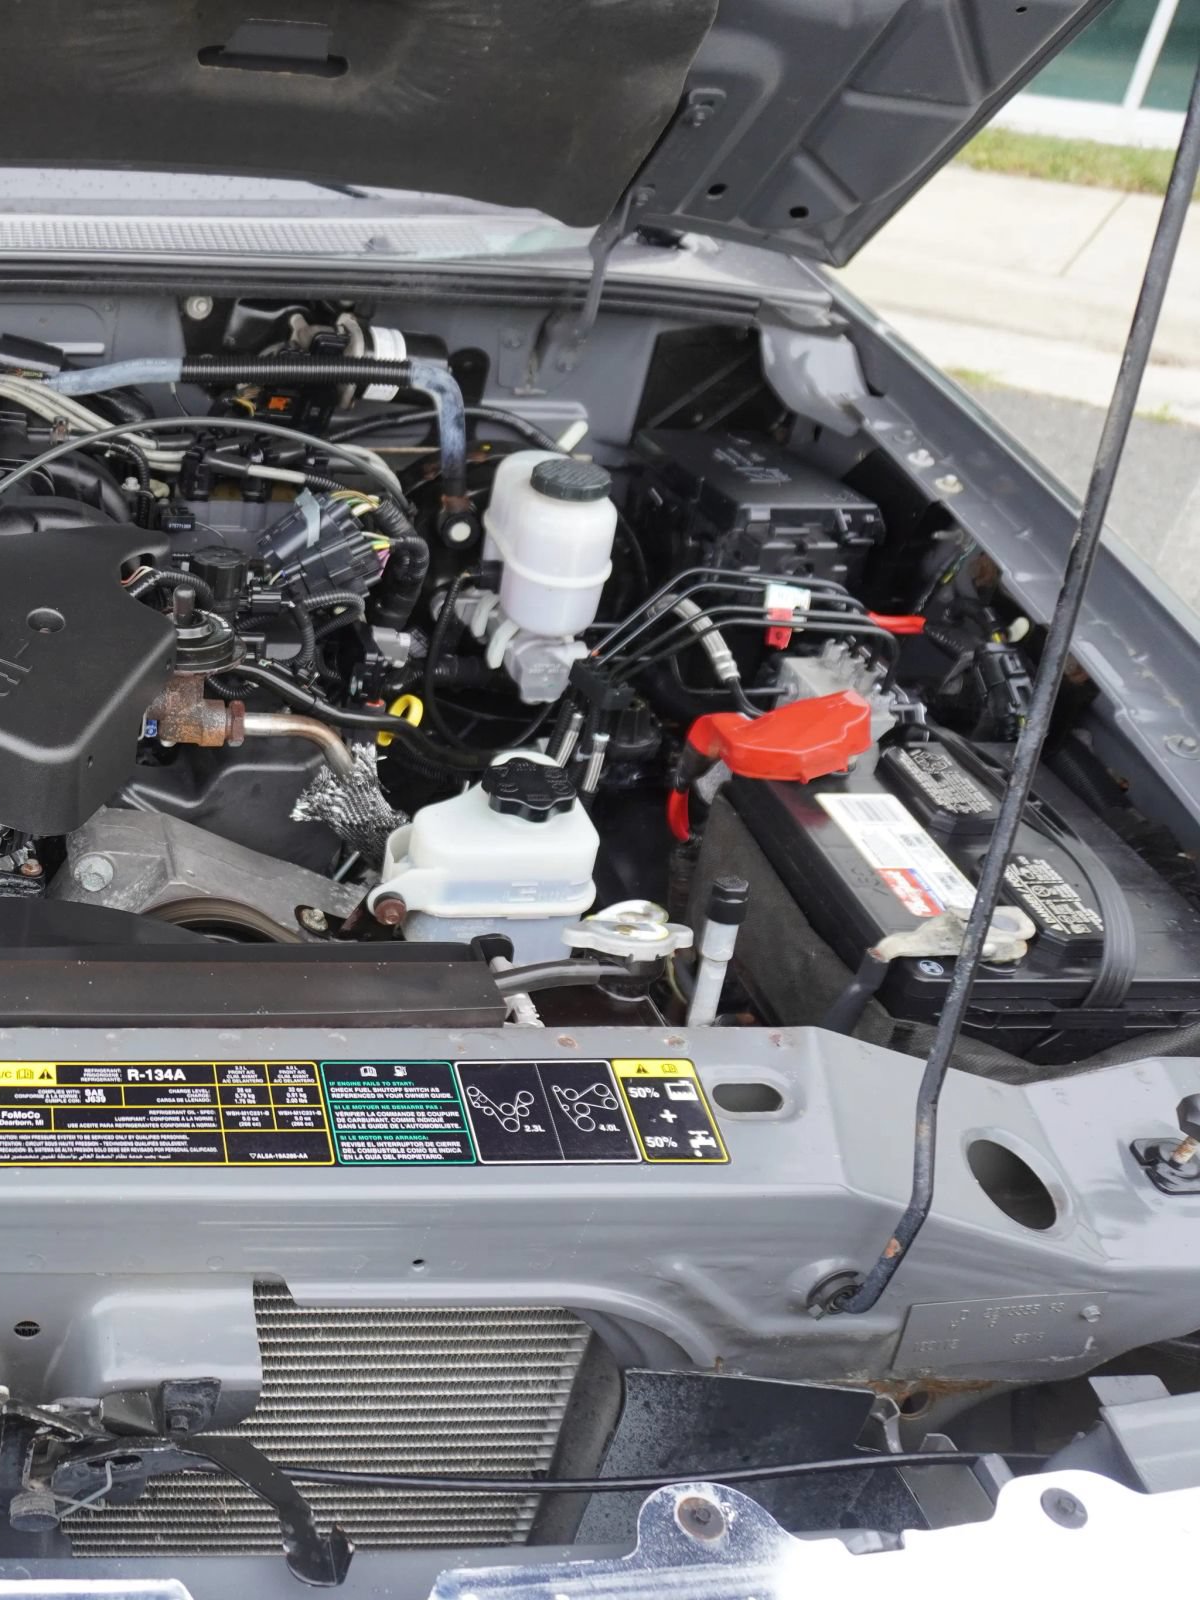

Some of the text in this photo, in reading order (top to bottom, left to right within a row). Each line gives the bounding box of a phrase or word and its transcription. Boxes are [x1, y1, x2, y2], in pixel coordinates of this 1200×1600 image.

[1021, 893, 1057, 924] DANGER
[127, 1069, 186, 1081] R-134A
[628, 1088, 660, 1099] 50%
[1, 1111, 40, 1119] FoMoCo
[645, 1137, 678, 1148] 50%
